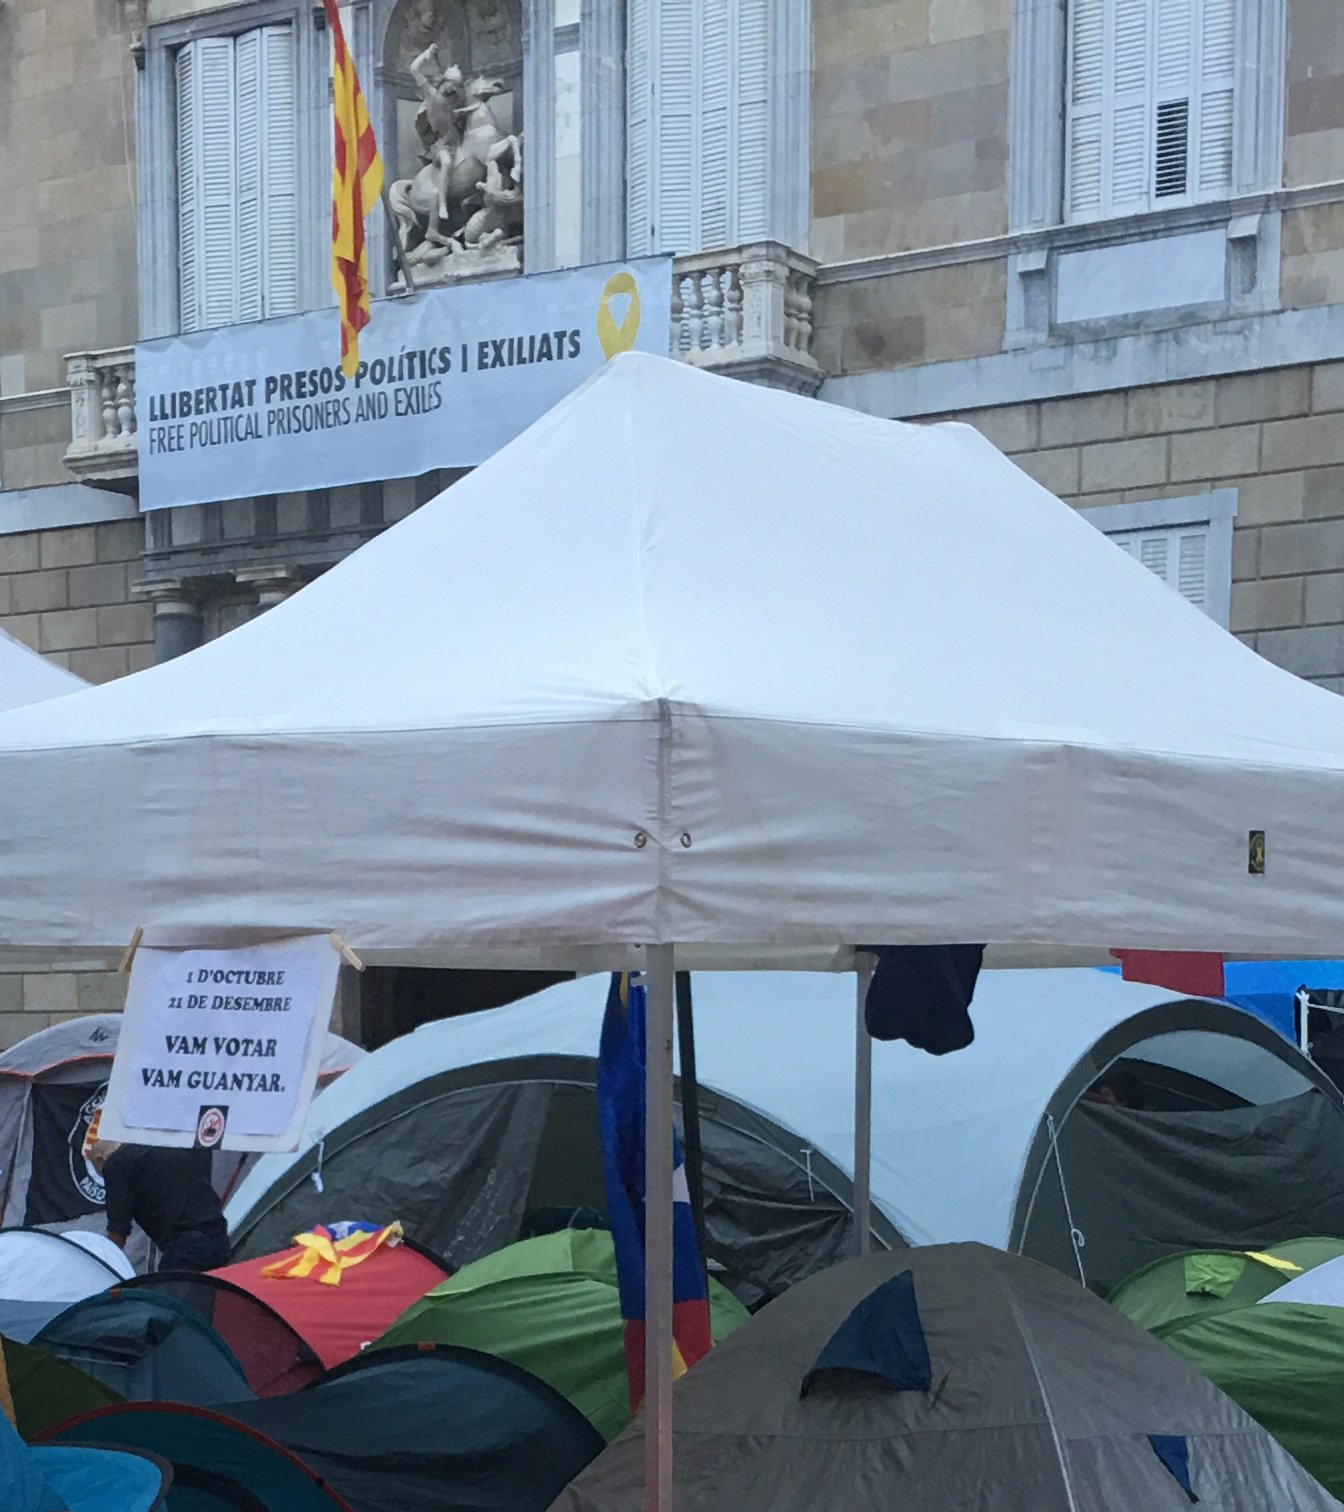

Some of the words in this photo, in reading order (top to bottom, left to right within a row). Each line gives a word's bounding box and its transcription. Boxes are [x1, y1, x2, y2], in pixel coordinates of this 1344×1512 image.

[149, 377, 256, 422] LLIBERTAT
[265, 362, 347, 404] PRESOS
[353, 344, 452, 388] POLÍTICS
[461, 343, 469, 373] I
[477, 328, 582, 370] EXILIATS
[149, 423, 186, 456] FREE
[189, 412, 263, 450] POLITICAL
[267, 395, 352, 437] PRISONERS
[354, 394, 389, 424] AND
[393, 381, 444, 418] EXILES
[186, 970, 193, 984] 1
[197, 969, 285, 986] D'OCTUBRE
[168, 997, 183, 1008] 21
[186, 994, 208, 1010] DE
[211, 995, 292, 1012] DESEMBRE
[165, 1035, 208, 1055] VAM
[214, 1038, 278, 1058] VOTAR
[142, 1067, 181, 1088] VAM
[187, 1072, 285, 1093] GUANYAR.
